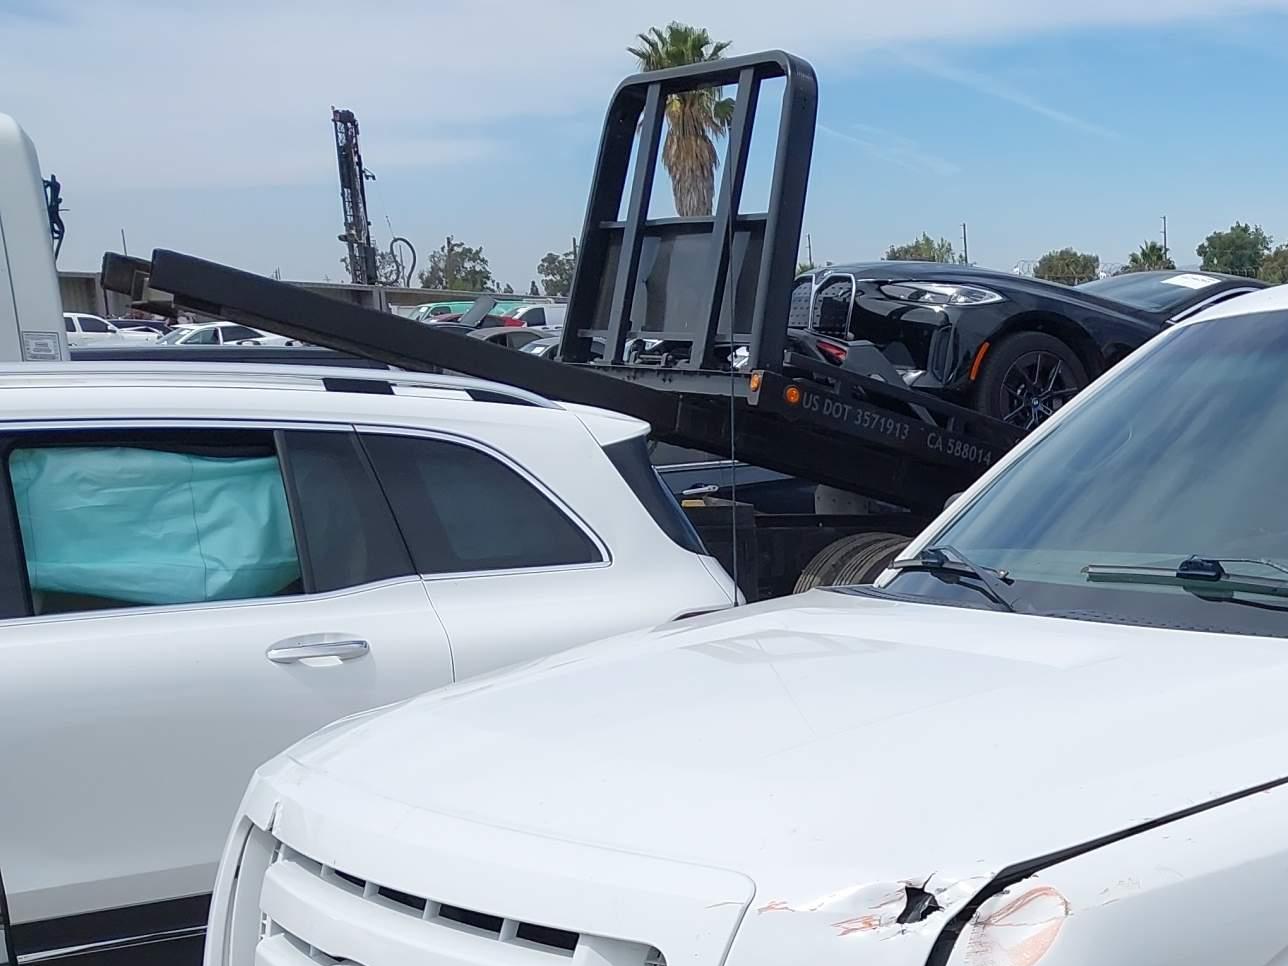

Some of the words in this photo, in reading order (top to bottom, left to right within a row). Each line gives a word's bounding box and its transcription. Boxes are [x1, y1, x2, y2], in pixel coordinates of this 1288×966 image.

[801, 391, 820, 412] US
[823, 399, 853, 422] DOT
[854, 408, 911, 441] 3571913
[926, 432, 944, 452] CA
[946, 438, 993, 466] 588014
